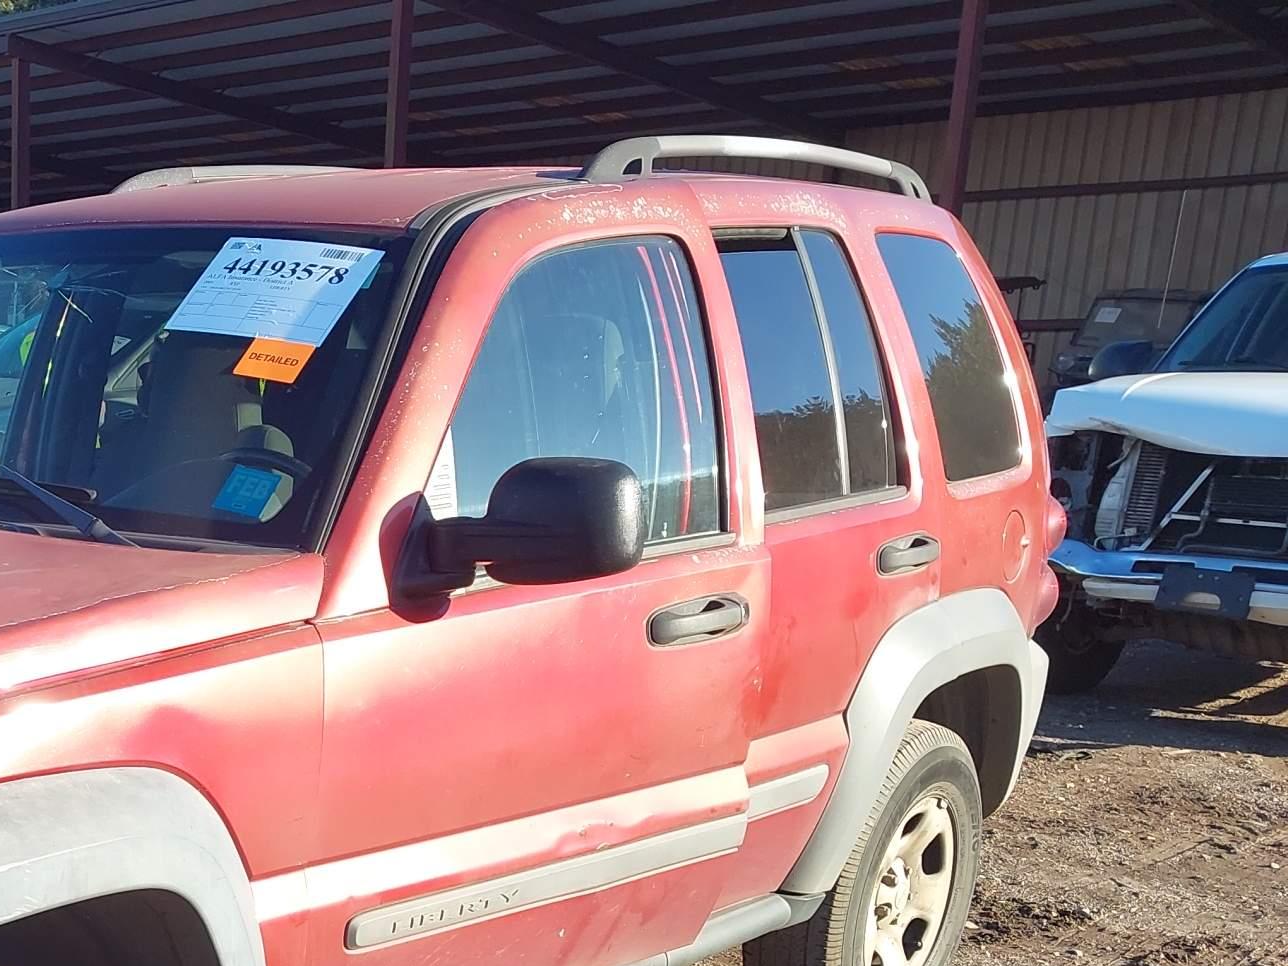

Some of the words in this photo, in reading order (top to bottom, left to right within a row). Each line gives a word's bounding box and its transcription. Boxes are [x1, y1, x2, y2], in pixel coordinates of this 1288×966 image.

[223, 257, 349, 285] 44193578
[248, 352, 299, 367] DETAILED
[389, 888, 520, 934] LIBERTY
